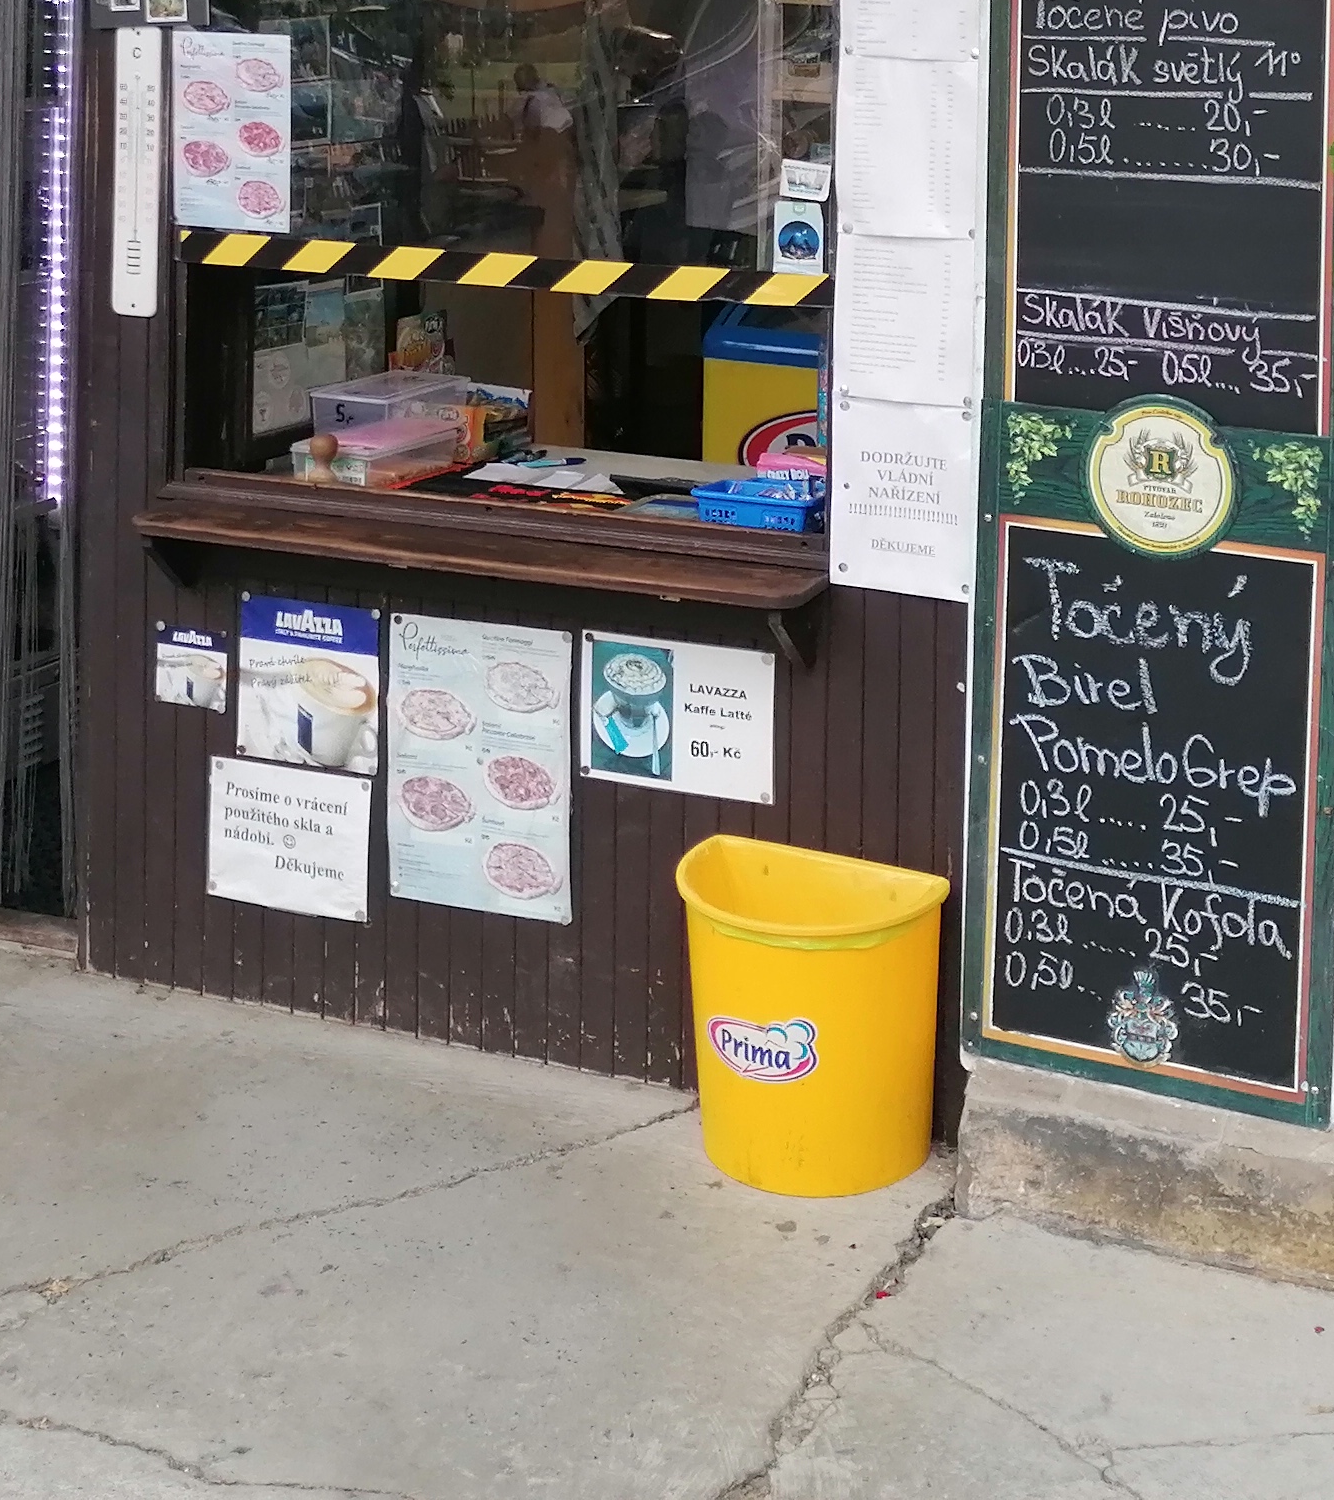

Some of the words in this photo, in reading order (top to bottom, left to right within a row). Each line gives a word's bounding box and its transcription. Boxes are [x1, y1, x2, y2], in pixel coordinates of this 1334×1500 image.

[1028, 44, 1142, 85] Skalák
[1152, 46, 1243, 103] světlý
[1022, 293, 1130, 337] Skalák
[1143, 306, 1261, 364] Višňový
[860, 450, 948, 471] DODRŽUJTE
[877, 467, 934, 486] VLÁDNÍ
[868, 484, 941, 505] NAŘÍZENÍ
[1116, 489, 1203, 514] ROHOZEC
[871, 537, 936, 557] DĚKUJEME
[275, 609, 343, 637] LAVAZZA
[1023, 556, 1251, 686] Točený
[172, 630, 213, 647] LAVAZZA
[690, 683, 748, 701] LAVAZZA
[1013, 654, 1158, 713] Birel
[684, 703, 717, 719] Kaffe
[722, 745, 742, 760] Kč
[1009, 714, 1177, 785] Pomelo
[1183, 734, 1296, 817] Grep
[225, 781, 280, 805] Prosíme
[296, 794, 348, 818] vrácení
[224, 805, 289, 830] použitého
[293, 814, 321, 832] skla
[325, 822, 334, 836] a
[274, 854, 345, 882] Děkujeme
[1010, 860, 1148, 926] Točená
[1161, 878, 1293, 960] Kofola
[721, 1028, 792, 1070] Prima
